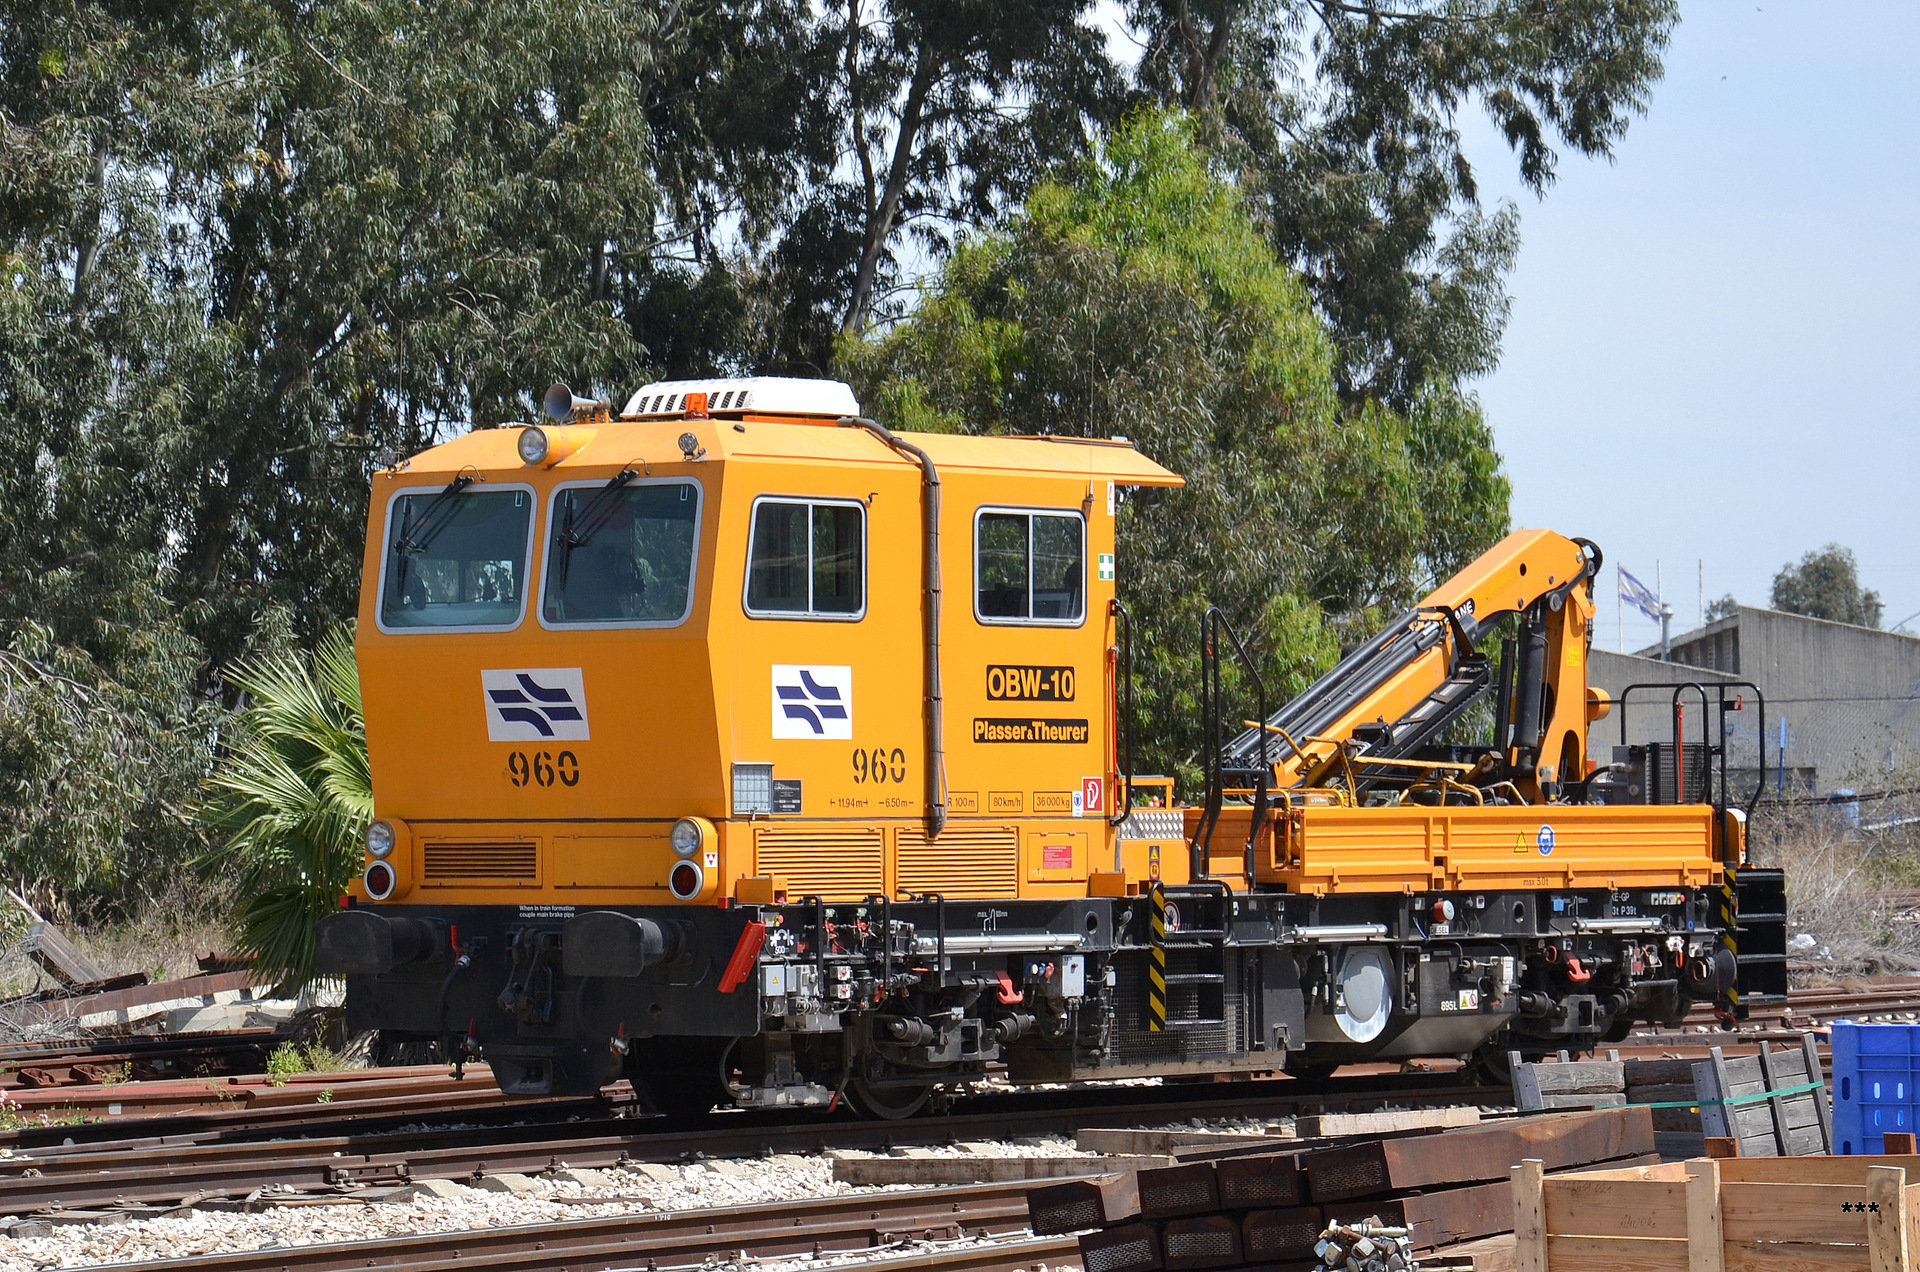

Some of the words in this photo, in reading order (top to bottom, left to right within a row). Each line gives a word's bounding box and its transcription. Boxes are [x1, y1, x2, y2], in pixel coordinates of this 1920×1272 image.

[1454, 600, 1474, 621] ANE
[988, 667, 1074, 699] OBW-10
[508, 750, 580, 787] 960
[852, 747, 906, 784] 960
[1587, 940, 1593, 950] 2
[971, 960, 976, 970] 1
[1440, 1000, 1458, 1011] 895L
